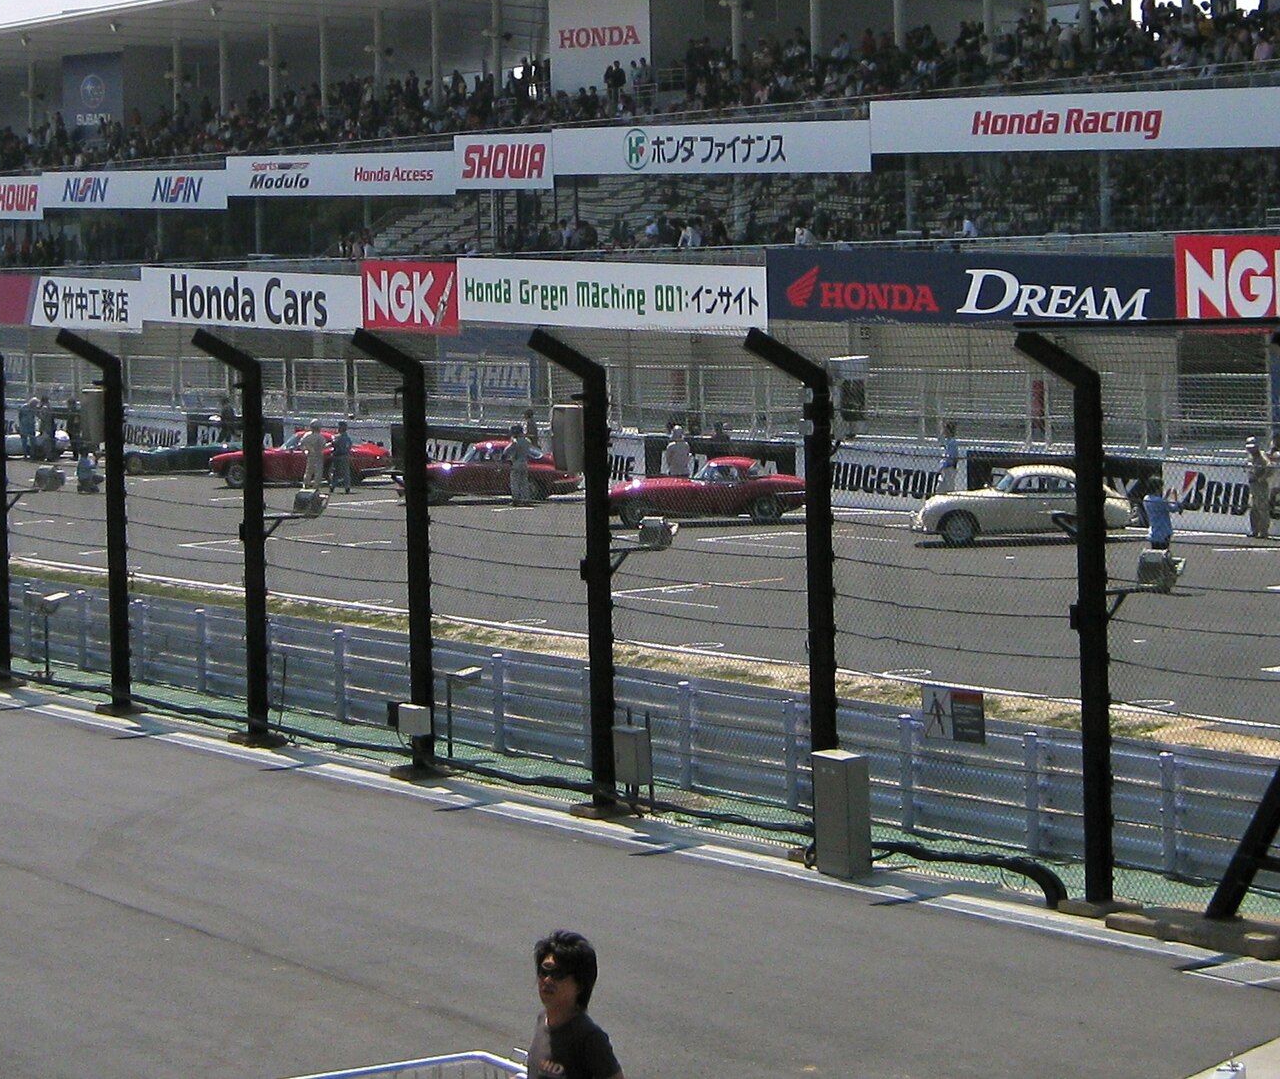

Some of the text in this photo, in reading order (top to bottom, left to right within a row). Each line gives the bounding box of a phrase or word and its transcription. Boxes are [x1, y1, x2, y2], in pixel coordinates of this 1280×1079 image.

[558, 25, 640, 49] HONDA
[971, 107, 1163, 140] Honda Racing
[461, 143, 546, 180] SHOWA
[651, 135, 787, 164] ホンダファイナンス
[249, 172, 310, 189] Modulo
[353, 166, 434, 182] Honda Access
[62, 285, 129, 323] 竹中工務店
[169, 272, 329, 328] Honda Cars
[367, 263, 438, 326] NGK
[464, 277, 511, 304] Honda
[519, 279, 568, 311] Green
[576, 280, 646, 315] Machine
[821, 281, 940, 313] HONDA
[955, 268, 1151, 321] DREAM
